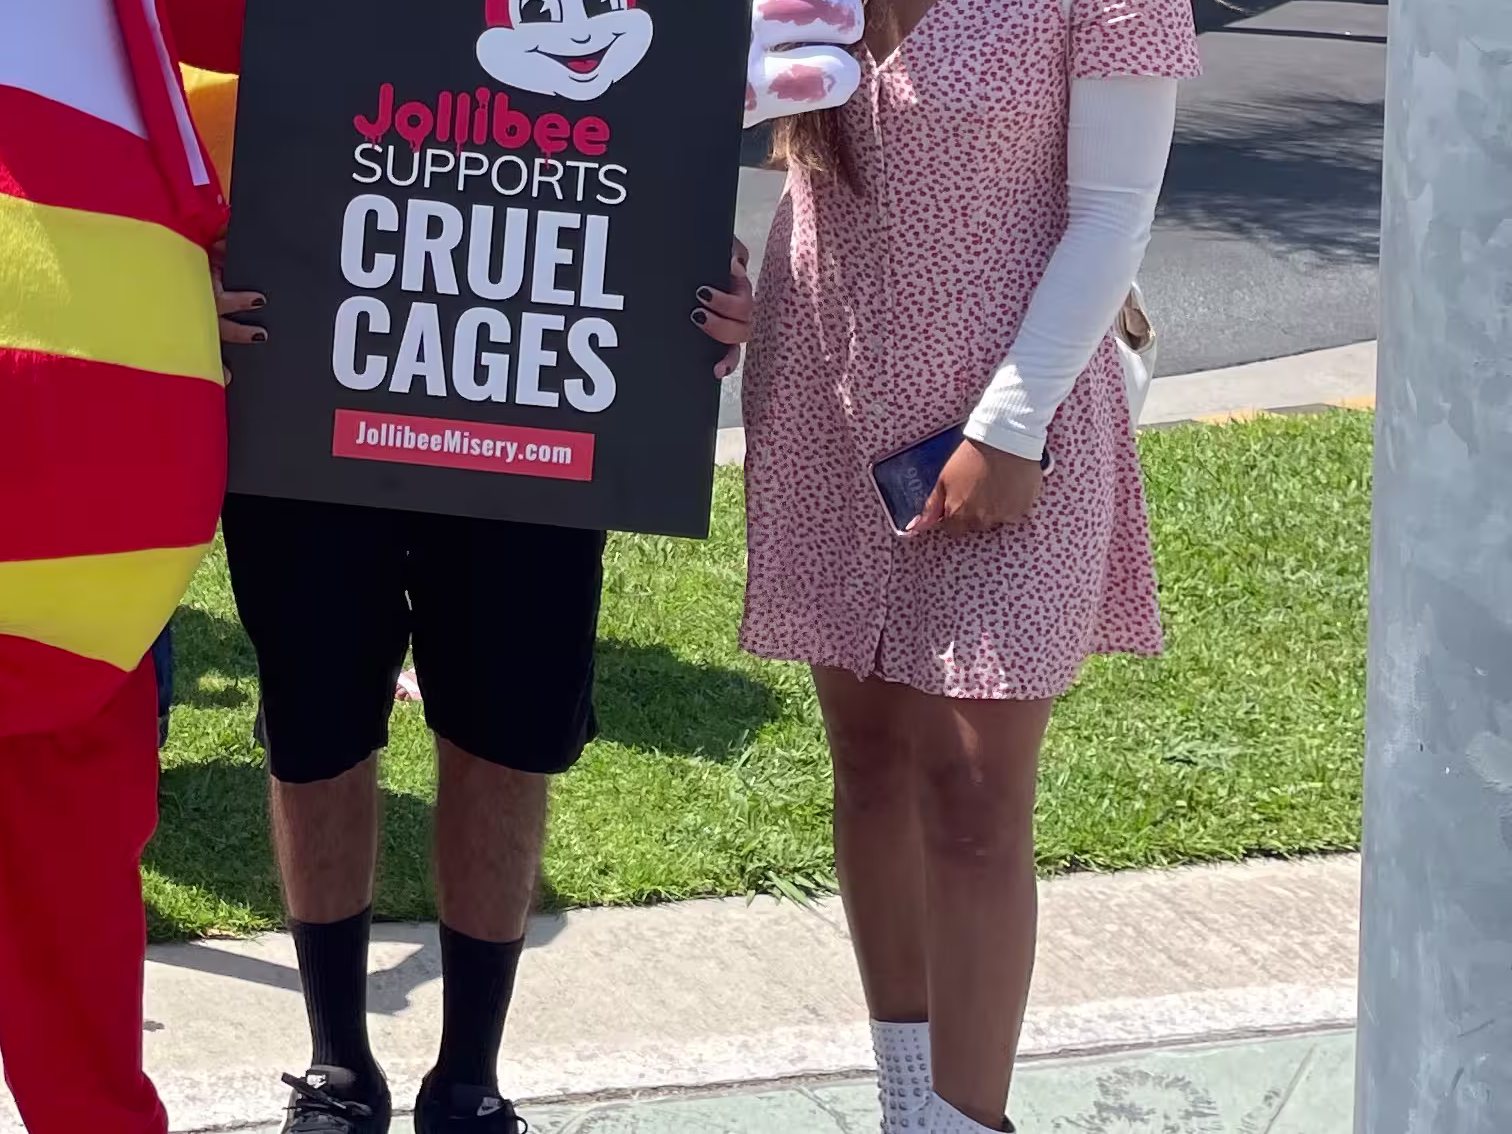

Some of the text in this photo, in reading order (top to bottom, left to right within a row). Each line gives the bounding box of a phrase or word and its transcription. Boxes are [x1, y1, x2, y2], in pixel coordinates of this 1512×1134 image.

[353, 83, 611, 157] Jollibee
[352, 142, 629, 205] SUPPORTS
[340, 193, 625, 311] CRUEL
[332, 294, 620, 413] CAGES
[355, 420, 573, 465] JollibeeMisery.com
